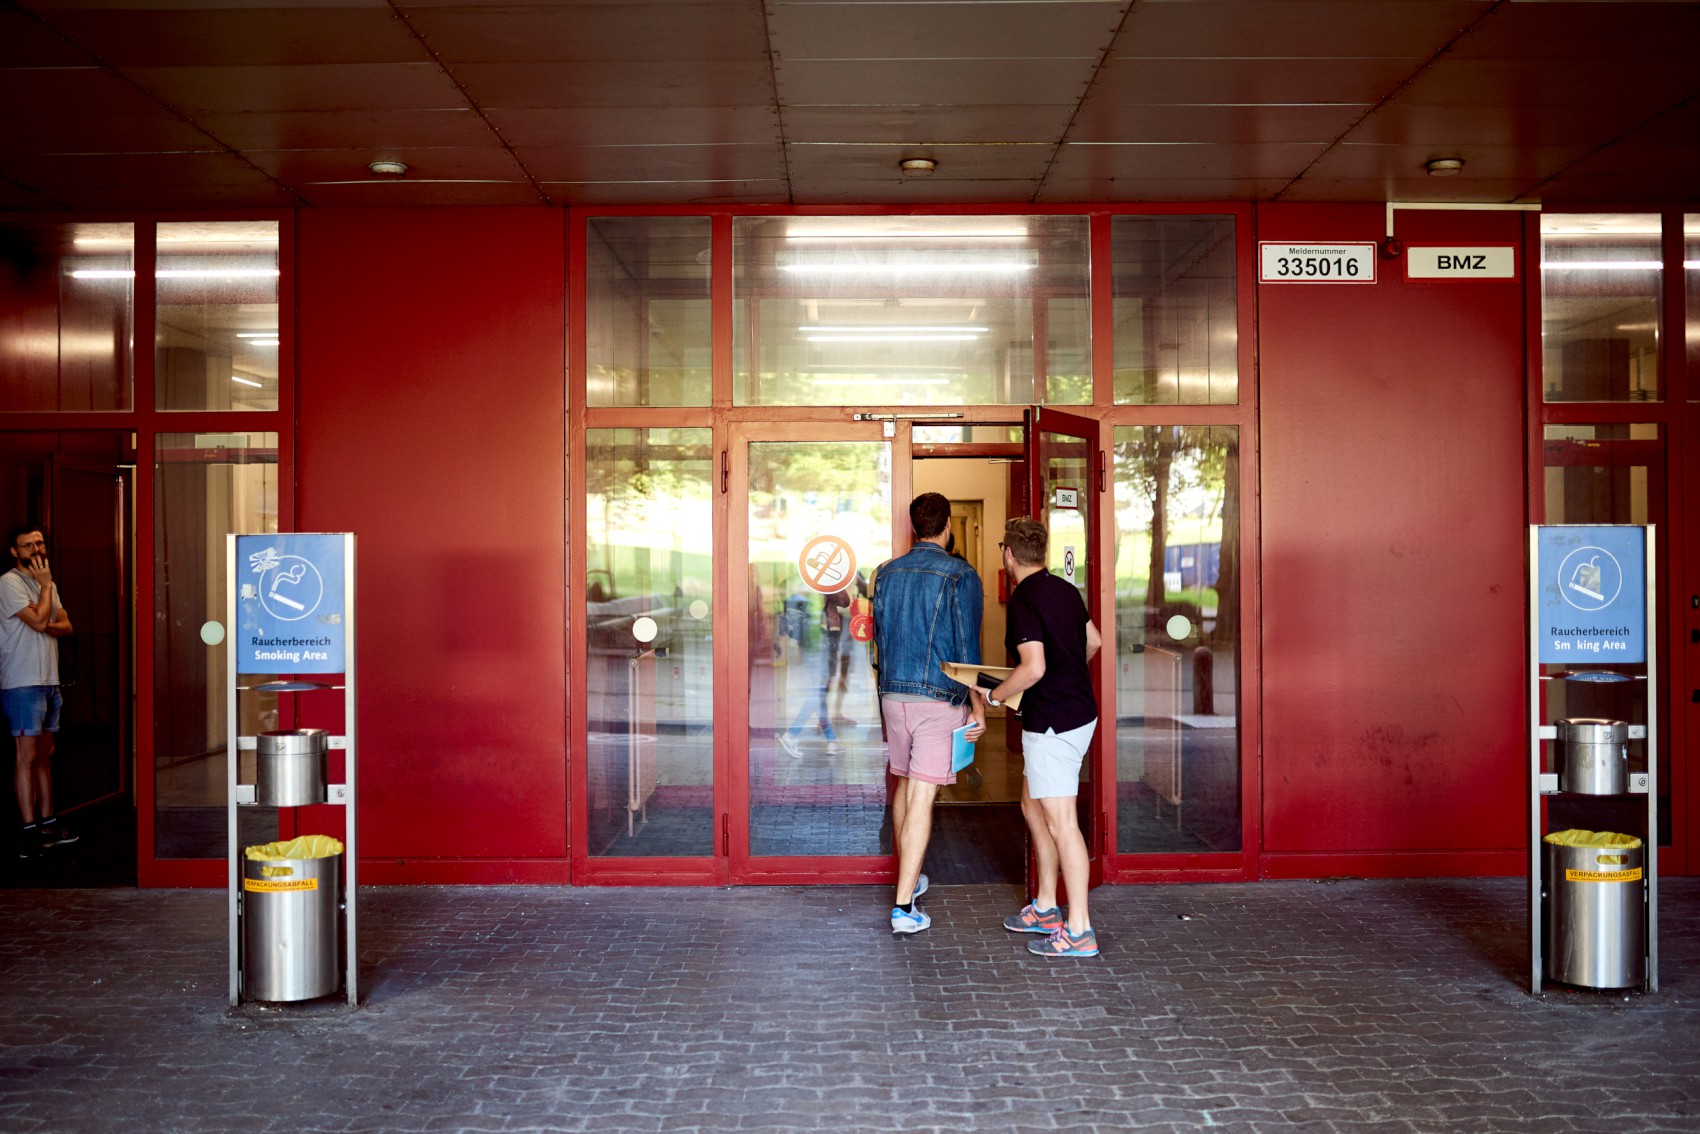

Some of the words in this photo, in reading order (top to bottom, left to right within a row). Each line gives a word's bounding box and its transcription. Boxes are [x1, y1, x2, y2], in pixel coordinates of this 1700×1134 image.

[1277, 257, 1359, 276] 335016
[1437, 255, 1486, 270] BMZ
[1061, 494, 1072, 503] BMZ
[1551, 626, 1630, 636] Raucherbereich
[251, 636, 331, 646] Raucherbereich
[1554, 640, 1600, 652] Smking
[1602, 640, 1626, 650] Area
[255, 650, 300, 663] Smoking
[302, 650, 328, 660] Area
[1569, 869, 1641, 878] VERPACKUNGSABFALL
